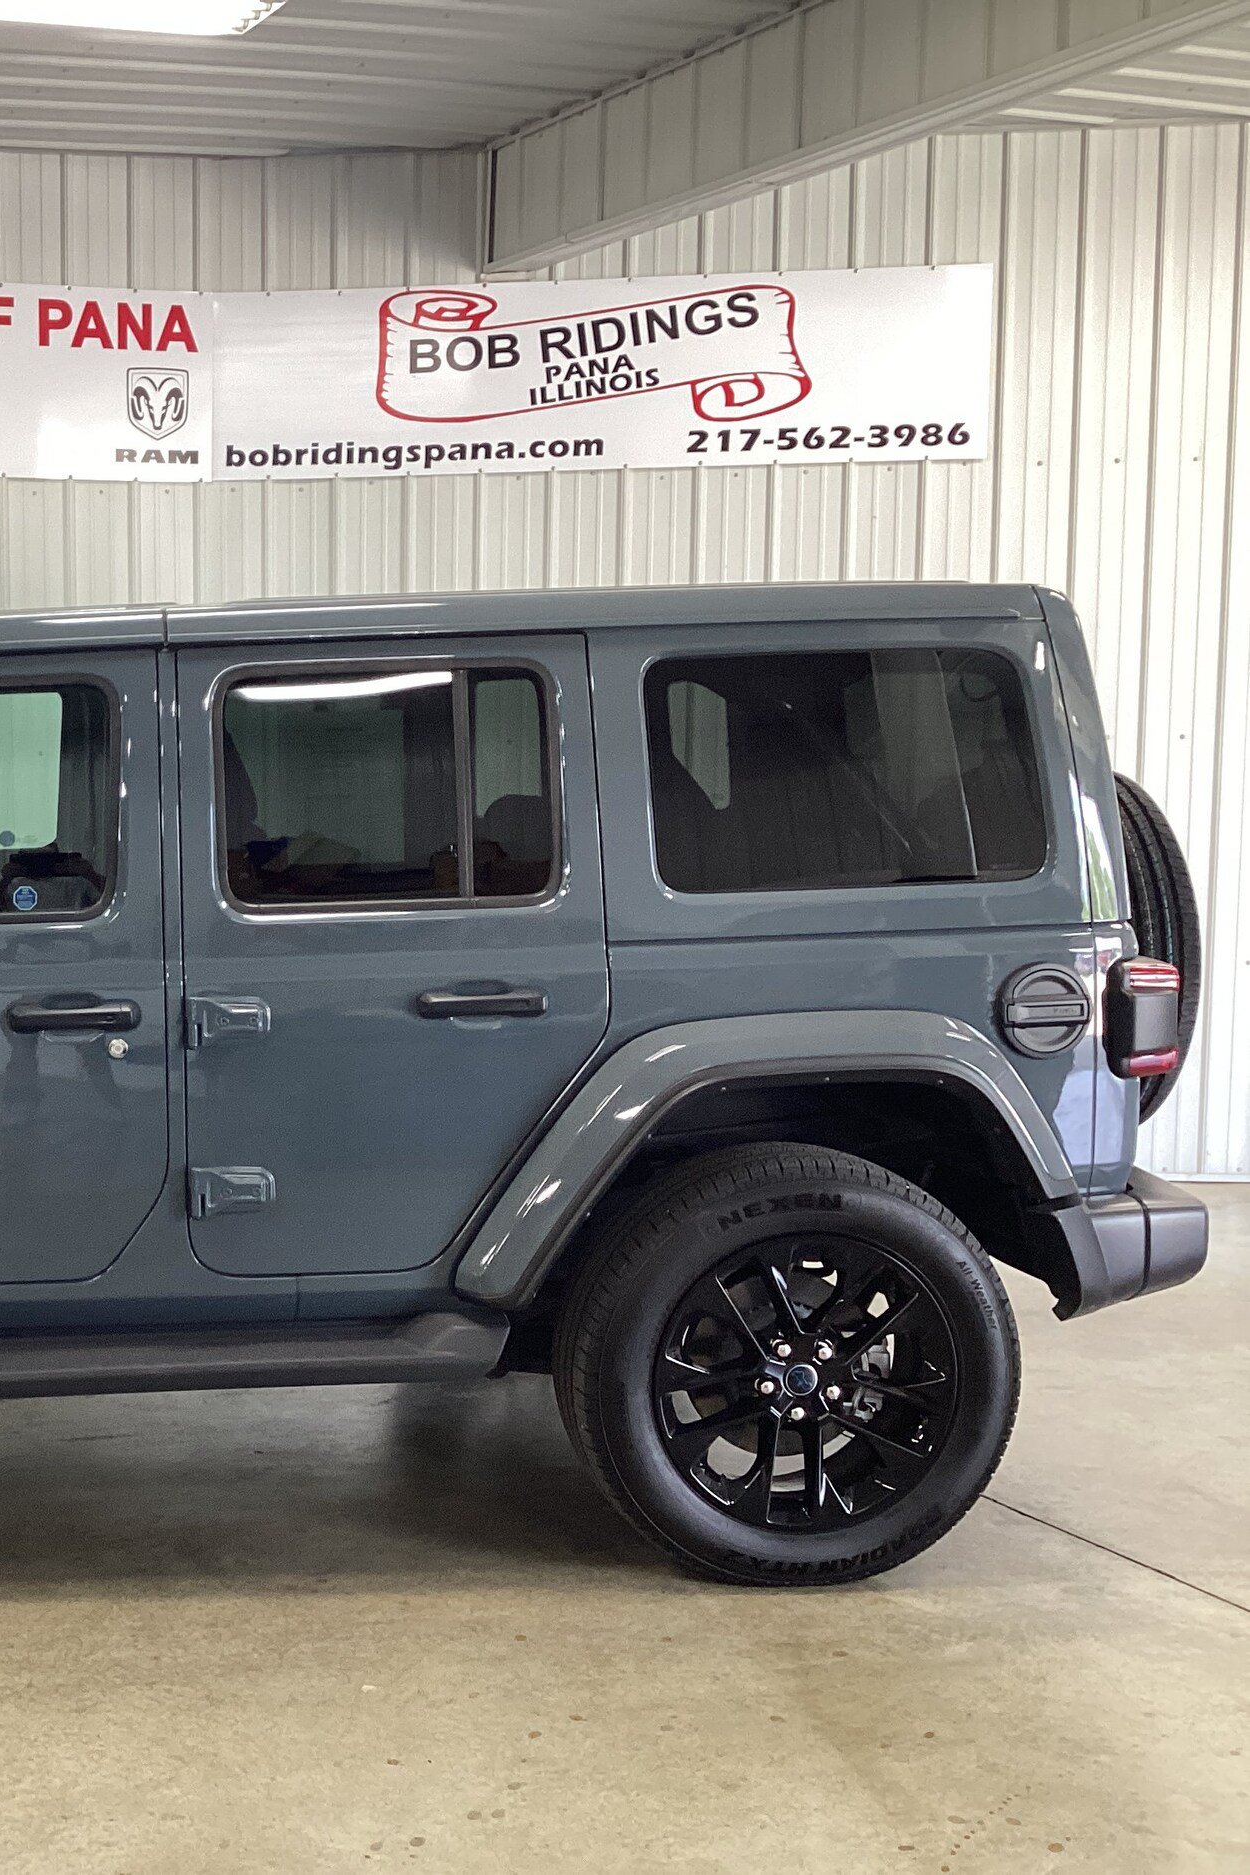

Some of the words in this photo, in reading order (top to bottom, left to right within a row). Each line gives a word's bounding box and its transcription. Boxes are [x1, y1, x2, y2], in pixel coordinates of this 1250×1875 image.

[37, 298, 198, 353] PANA
[409, 333, 521, 374] BOB
[539, 292, 760, 364] RIDINGS
[529, 367, 661, 406] ILLINOIS
[545, 354, 636, 385] PANA
[115, 448, 199, 465] RAM
[225, 438, 605, 471] bobridingspana.com
[686, 422, 970, 454] 217-562-3986
[717, 1192, 843, 1233] NEXEN
[956, 1260, 998, 1330] All-Weather
